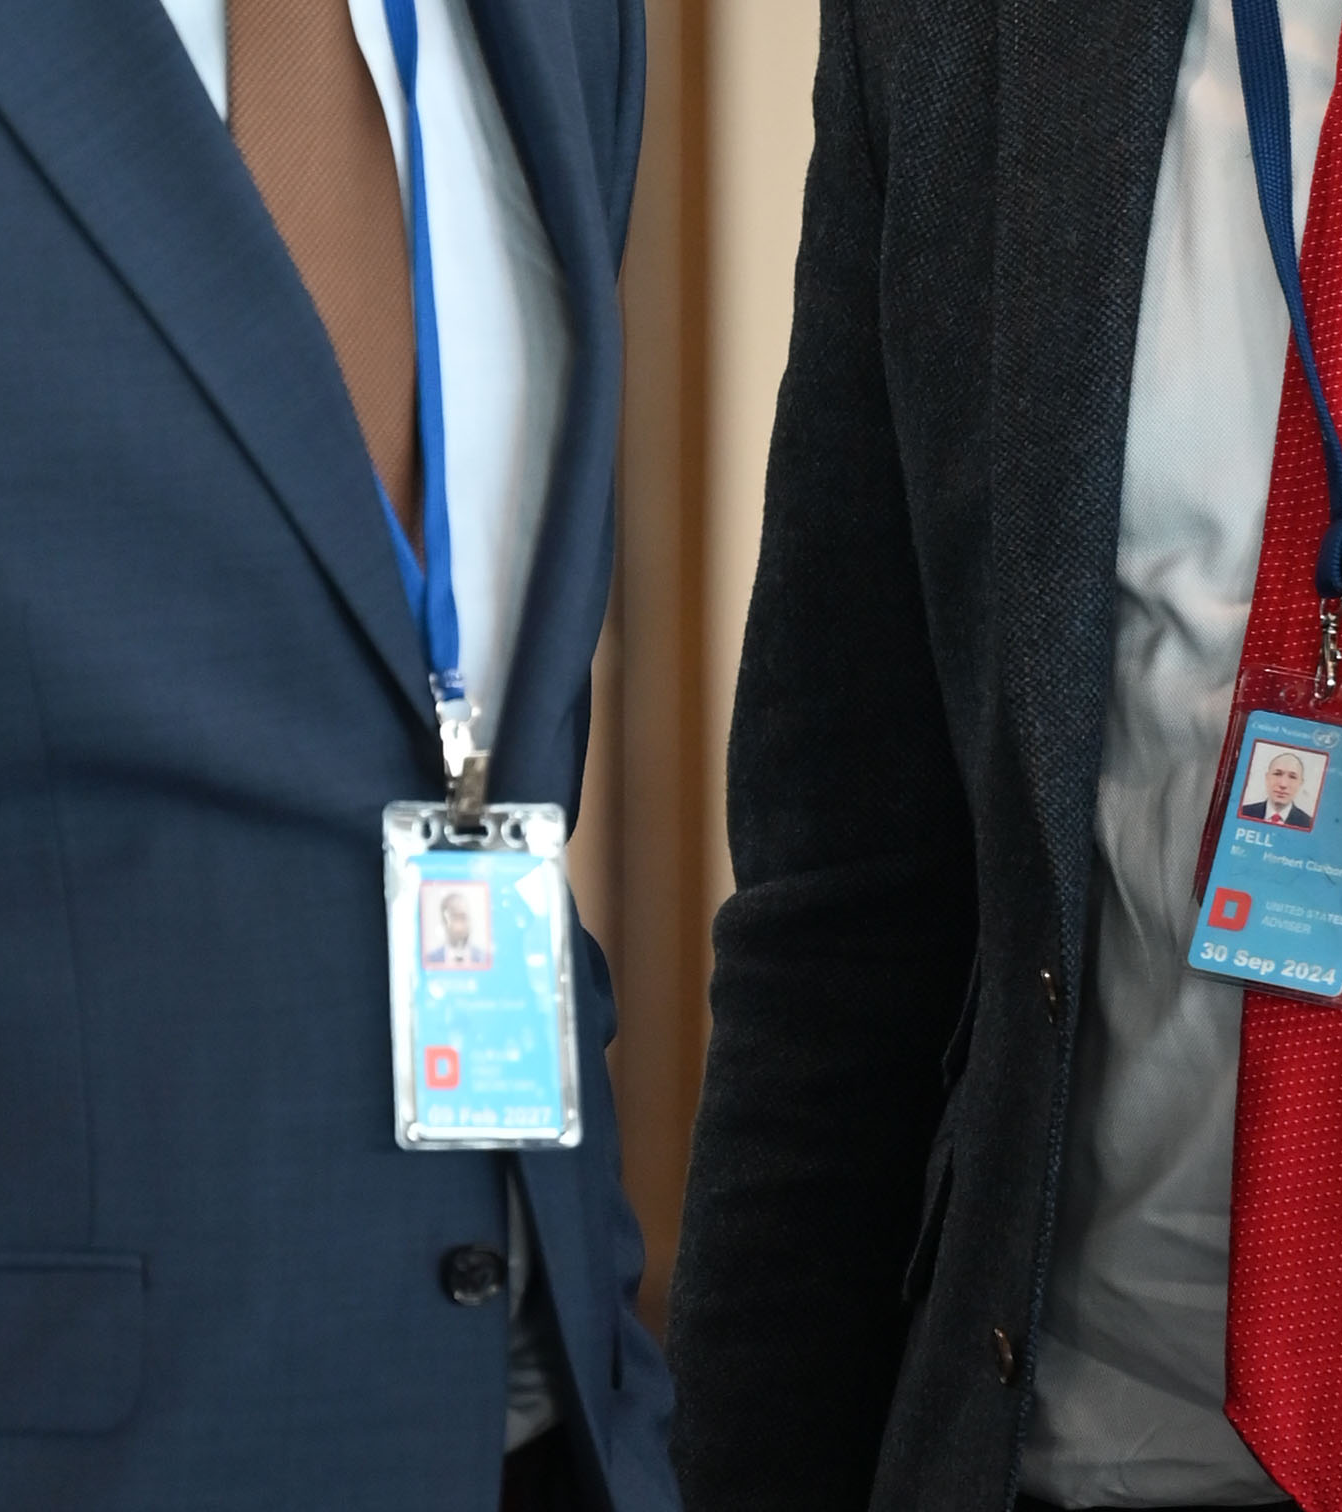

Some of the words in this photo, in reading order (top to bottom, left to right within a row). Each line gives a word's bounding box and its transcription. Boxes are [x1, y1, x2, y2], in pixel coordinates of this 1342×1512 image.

[1234, 827, 1273, 848] PELL
[1199, 941, 1229, 963] 30
[1232, 948, 1276, 976] Sep
[1280, 959, 1337, 986] 2024
